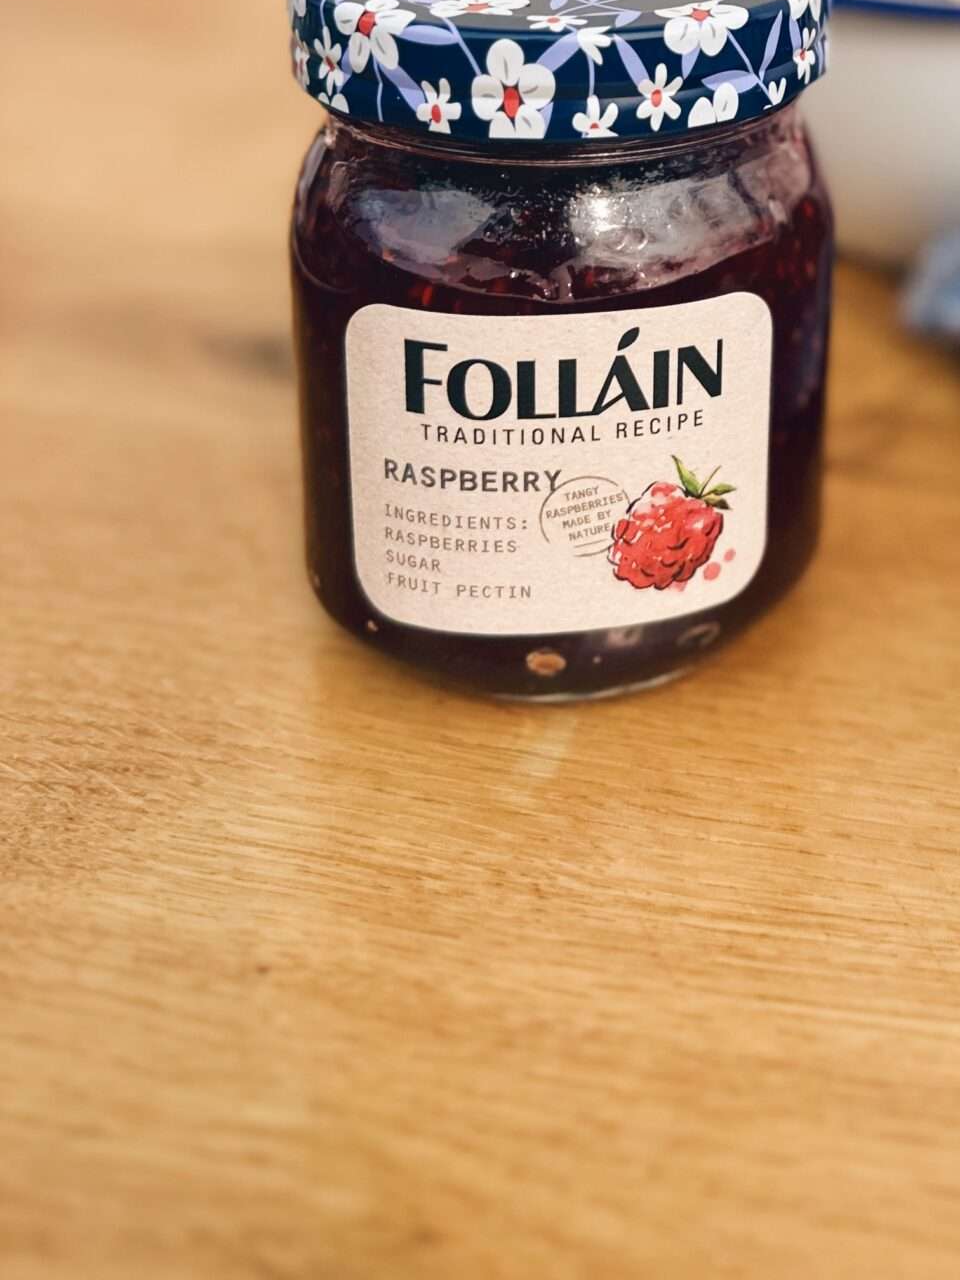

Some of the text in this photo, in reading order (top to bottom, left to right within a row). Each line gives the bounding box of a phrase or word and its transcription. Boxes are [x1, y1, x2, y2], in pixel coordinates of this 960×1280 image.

[421, 409, 704, 445] TRADITIONAL RECIPE
[384, 458, 562, 492] RASPBERRY
[545, 493, 624, 519] RASPBERRIES
[565, 486, 599, 501] TANGY
[384, 504, 528, 530] INGREDIENTS:
[562, 510, 612, 529] MADE BY
[385, 528, 517, 553] RASPBERRIES
[568, 523, 611, 541] NATURE
[386, 550, 441, 571] SUGAR
[387, 572, 531, 598] FRUIT PECTIN
